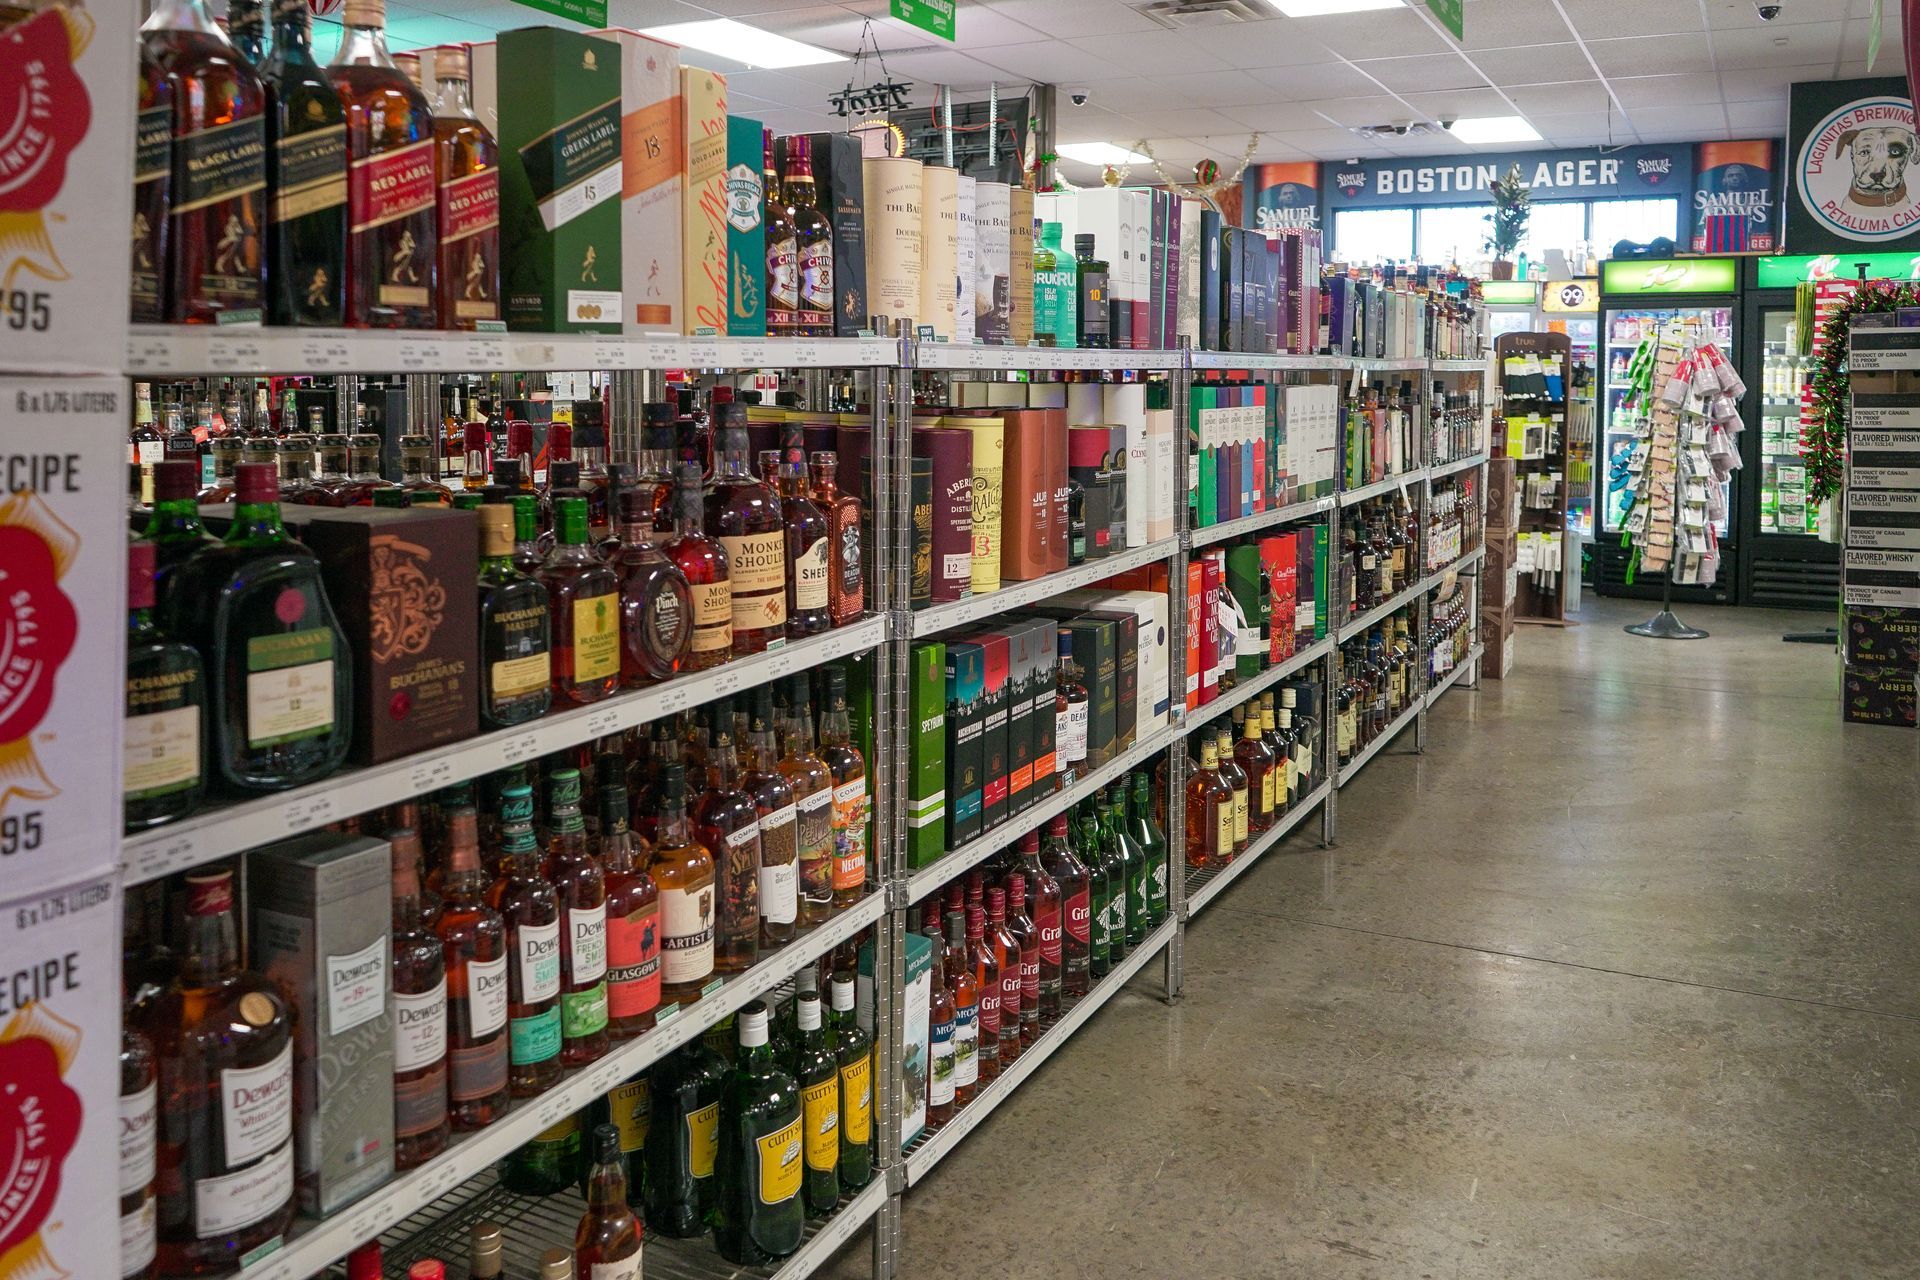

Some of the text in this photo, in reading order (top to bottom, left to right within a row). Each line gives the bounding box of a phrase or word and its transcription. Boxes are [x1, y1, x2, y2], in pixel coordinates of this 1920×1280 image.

[561, 135, 591, 158] GREEN
[590, 122, 617, 143] LABEL
[645, 135, 661, 160] 18
[1807, 106, 1915, 175] LAGUNITAS BREWING
[187, 151, 231, 171] BLACK
[691, 146, 727, 167] GOLD LABEL
[1637, 158, 1672, 169] SAMUEL
[370, 176, 397, 193] RED
[398, 163, 433, 184] LABEL
[1336, 173, 1367, 183] SAMUEL
[1376, 158, 1618, 195] BOSTON LAGER
[1639, 164, 1670, 176] ADAMS
[1339, 179, 1365, 188] ADAMS
[449, 187, 499, 212] RED LABEL
[585, 185, 596, 201] 15
[1693, 188, 1774, 210] SAMUEL
[886, 204, 905, 213] THE
[940, 211, 953, 220] THE
[1256, 205, 1320, 225] SAMUEL
[1697, 205, 1768, 226] ADAMS
[1821, 200, 1890, 232] PETALUMA
[912, 243, 920, 254] 12
[1751, 239, 1773, 250] GER
[967, 249, 974, 260] 12
[1089, 289, 1101, 301] 10
[1561, 287, 1584, 305] 99
[0, 290, 52, 332] 95
[774, 313, 789, 324] XII
[804, 313, 819, 324] XII
[920, 327, 932, 336] STAFF
[1515, 336, 1537, 346] true
[16, 389, 118, 414] 6 x 1.75 LITERS
[1853, 434, 1920, 443] FLAVORED WHISKY
[1850, 493, 1918, 503] FLAVORED WHISKY
[971, 535, 990, 558] 13
[1846, 552, 1914, 562] FLAVORED WHISKY
[844, 567, 860, 578] DEACON
[946, 563, 958, 574] 12
[1879, 588, 1902, 596] CANADA
[494, 604, 547, 623] BUCHANAN'S
[656, 596, 680, 614] Pinch
[10, 588, 38, 647] 1795
[505, 618, 541, 632] MASTER
[922, 713, 944, 734] SPEYBURN
[16, 881, 112, 930] 6 x 1.75 LITERS
[667, 932, 706, 949] ARTIST
[334, 956, 382, 986] Dewar's
[606, 960, 656, 982] GLASGOW
[399, 999, 447, 1025] Dewar's
[422, 1026, 434, 1039] 12
[618, 1084, 647, 1101] CUTTY
[806, 1085, 833, 1103] CUTTY
[768, 1128, 795, 1150] CUTTY
